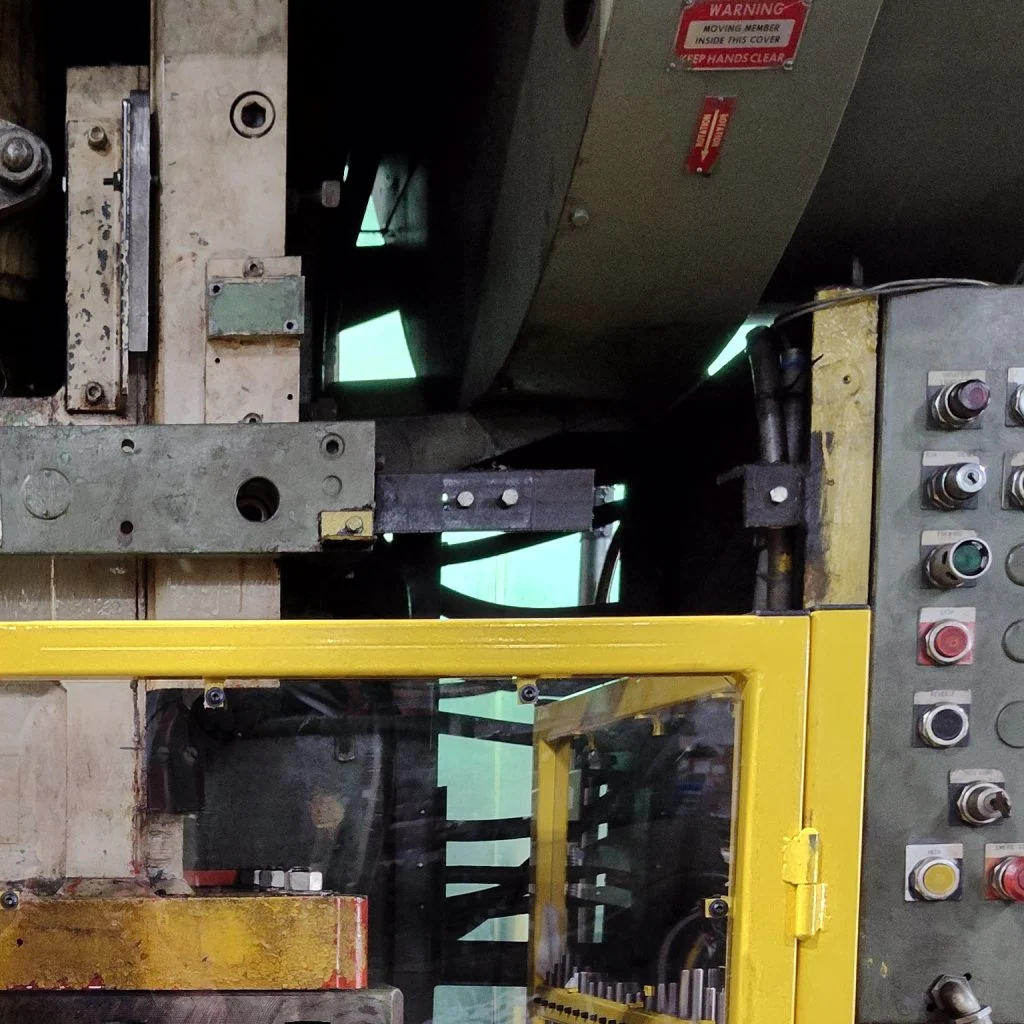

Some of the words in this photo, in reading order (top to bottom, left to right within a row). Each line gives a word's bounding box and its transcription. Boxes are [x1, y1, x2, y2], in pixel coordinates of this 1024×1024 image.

[709, 3, 785, 16] WARNING
[703, 24, 741, 33] MOVING
[744, 23, 781, 32] MEMBER
[695, 36, 725, 45] INSIDE
[727, 36, 747, 44] THIS
[749, 35, 781, 44] COVER
[706, 53, 748, 64] HANDS
[749, 53, 785, 63] CLEAR
